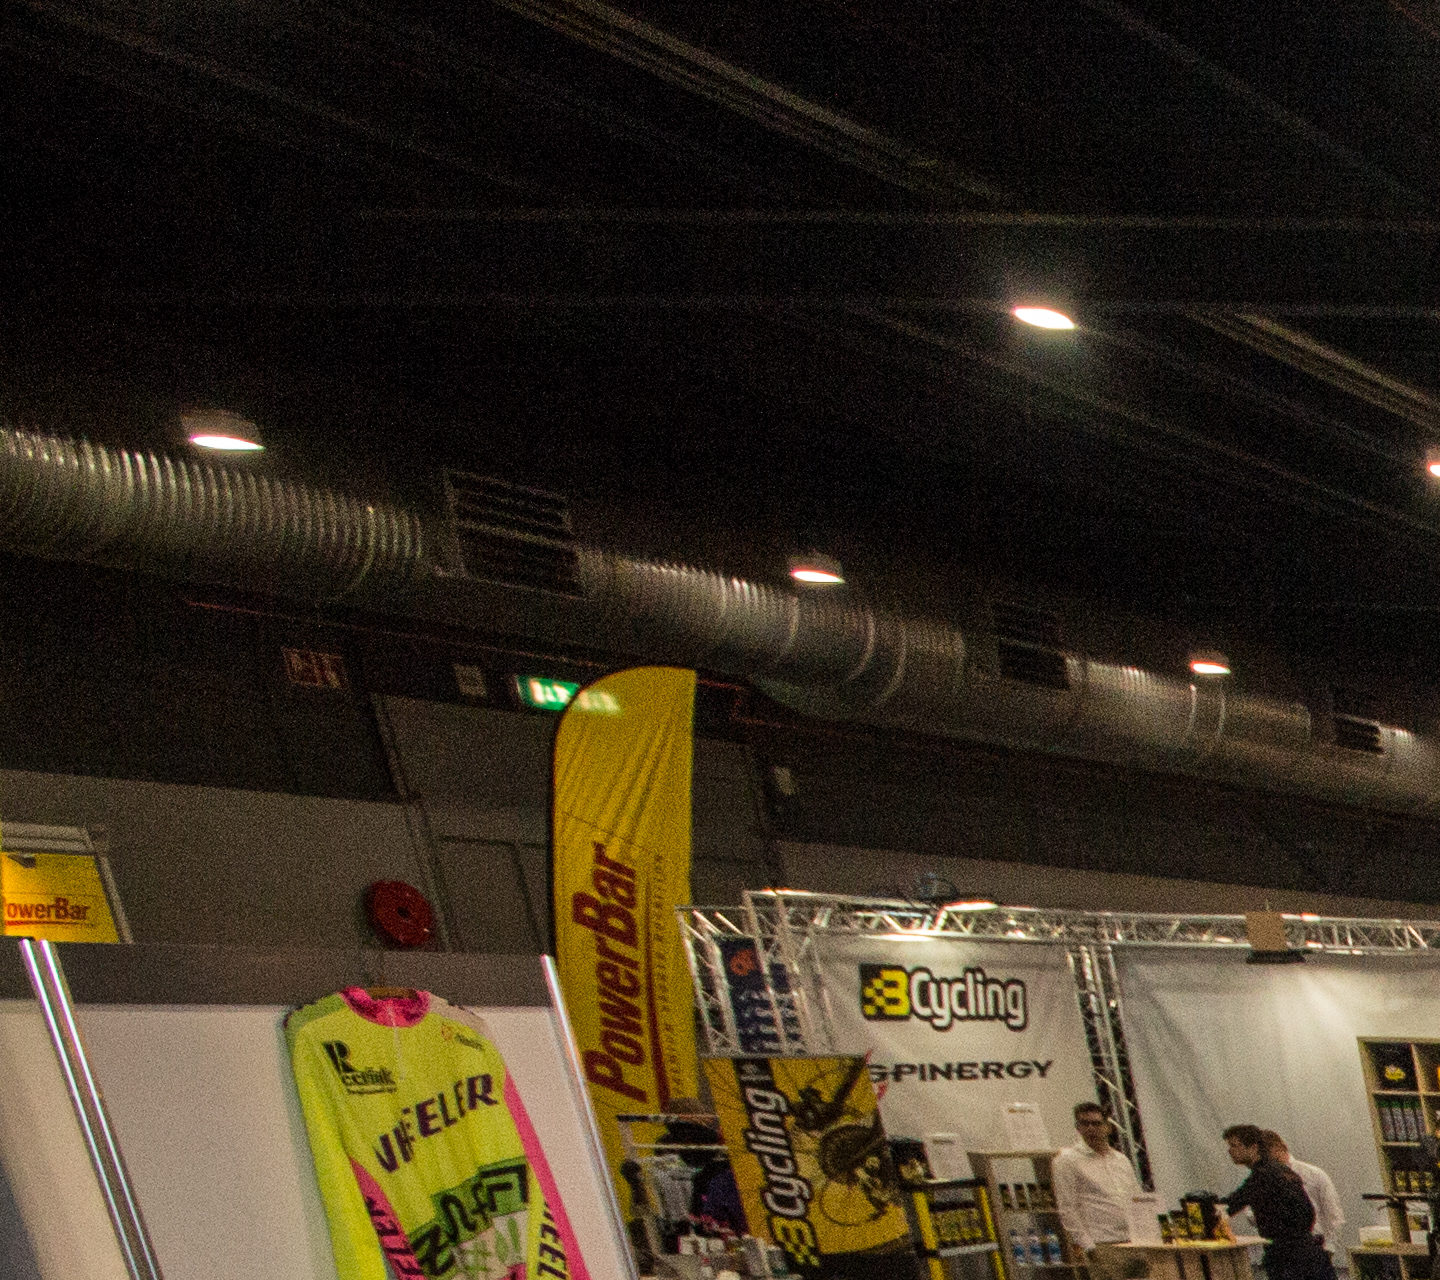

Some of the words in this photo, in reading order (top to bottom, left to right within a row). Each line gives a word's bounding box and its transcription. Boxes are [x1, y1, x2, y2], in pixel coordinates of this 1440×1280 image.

[1, 896, 91, 921] owerBar
[572, 841, 648, 1104] PowerBar
[869, 1060, 1054, 1082] SPINERGY
